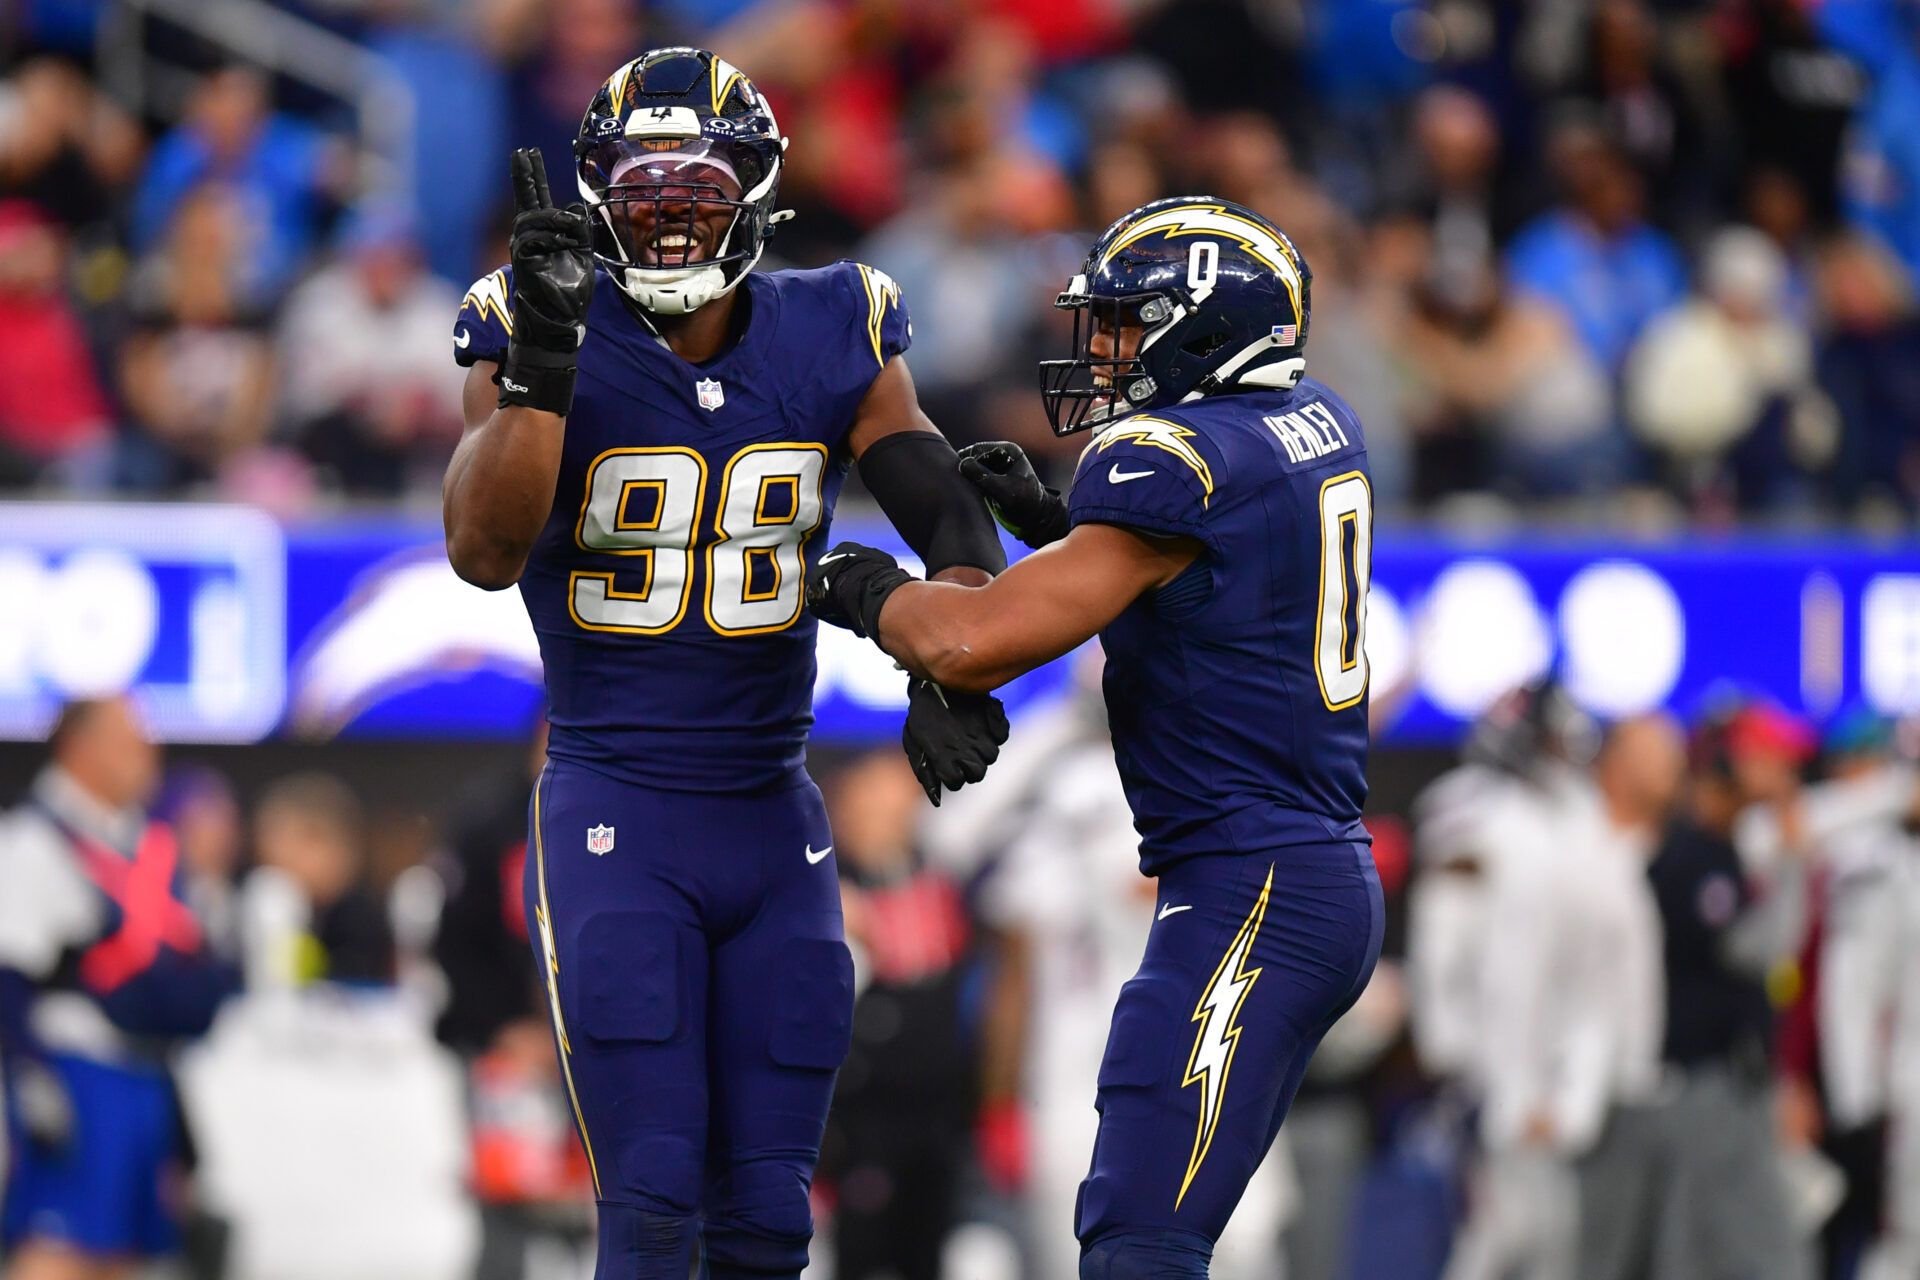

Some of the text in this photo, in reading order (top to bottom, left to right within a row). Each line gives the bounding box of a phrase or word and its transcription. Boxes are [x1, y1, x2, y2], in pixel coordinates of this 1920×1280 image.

[650, 107, 672, 122] LA
[704, 126, 735, 136] OAKLEY
[1187, 241, 1220, 289] 0
[1263, 401, 1350, 464] HENLEY
[568, 442, 828, 636] 98
[1314, 470, 1372, 711] 0
[592, 837, 610, 849] NFL
